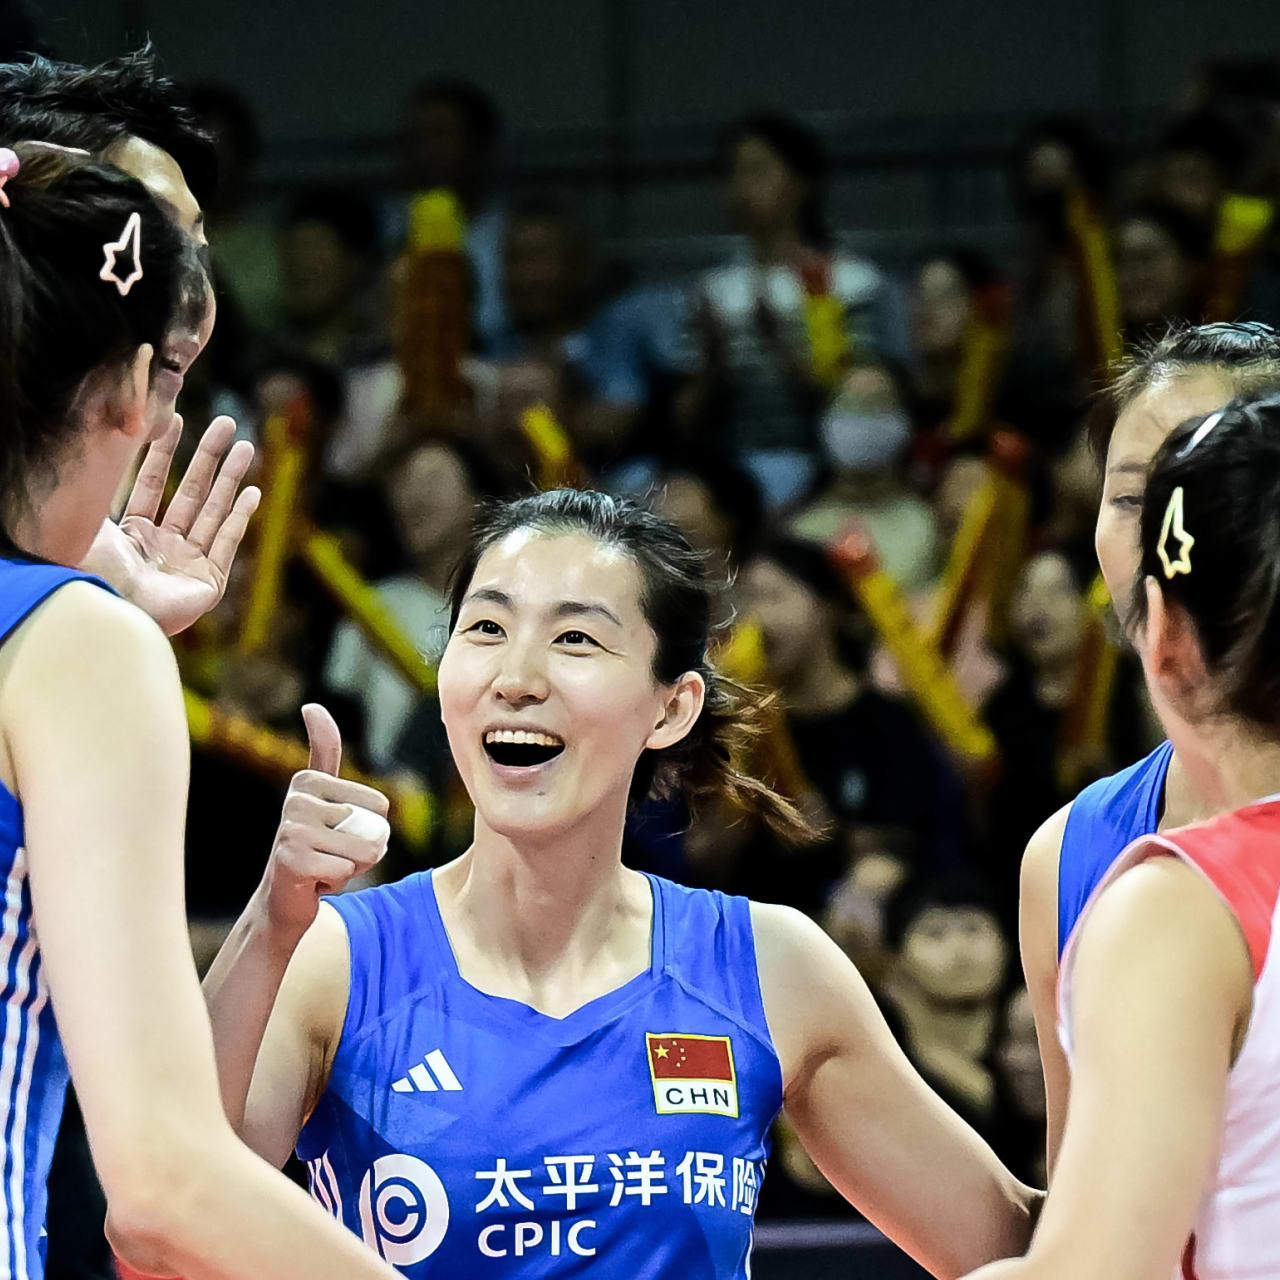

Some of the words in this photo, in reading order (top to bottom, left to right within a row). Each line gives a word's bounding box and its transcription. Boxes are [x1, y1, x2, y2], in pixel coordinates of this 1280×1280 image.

[665, 1087, 730, 1108] CHN
[473, 1149, 758, 1217] 太平洋保险
[477, 1219, 597, 1258] CPIC
